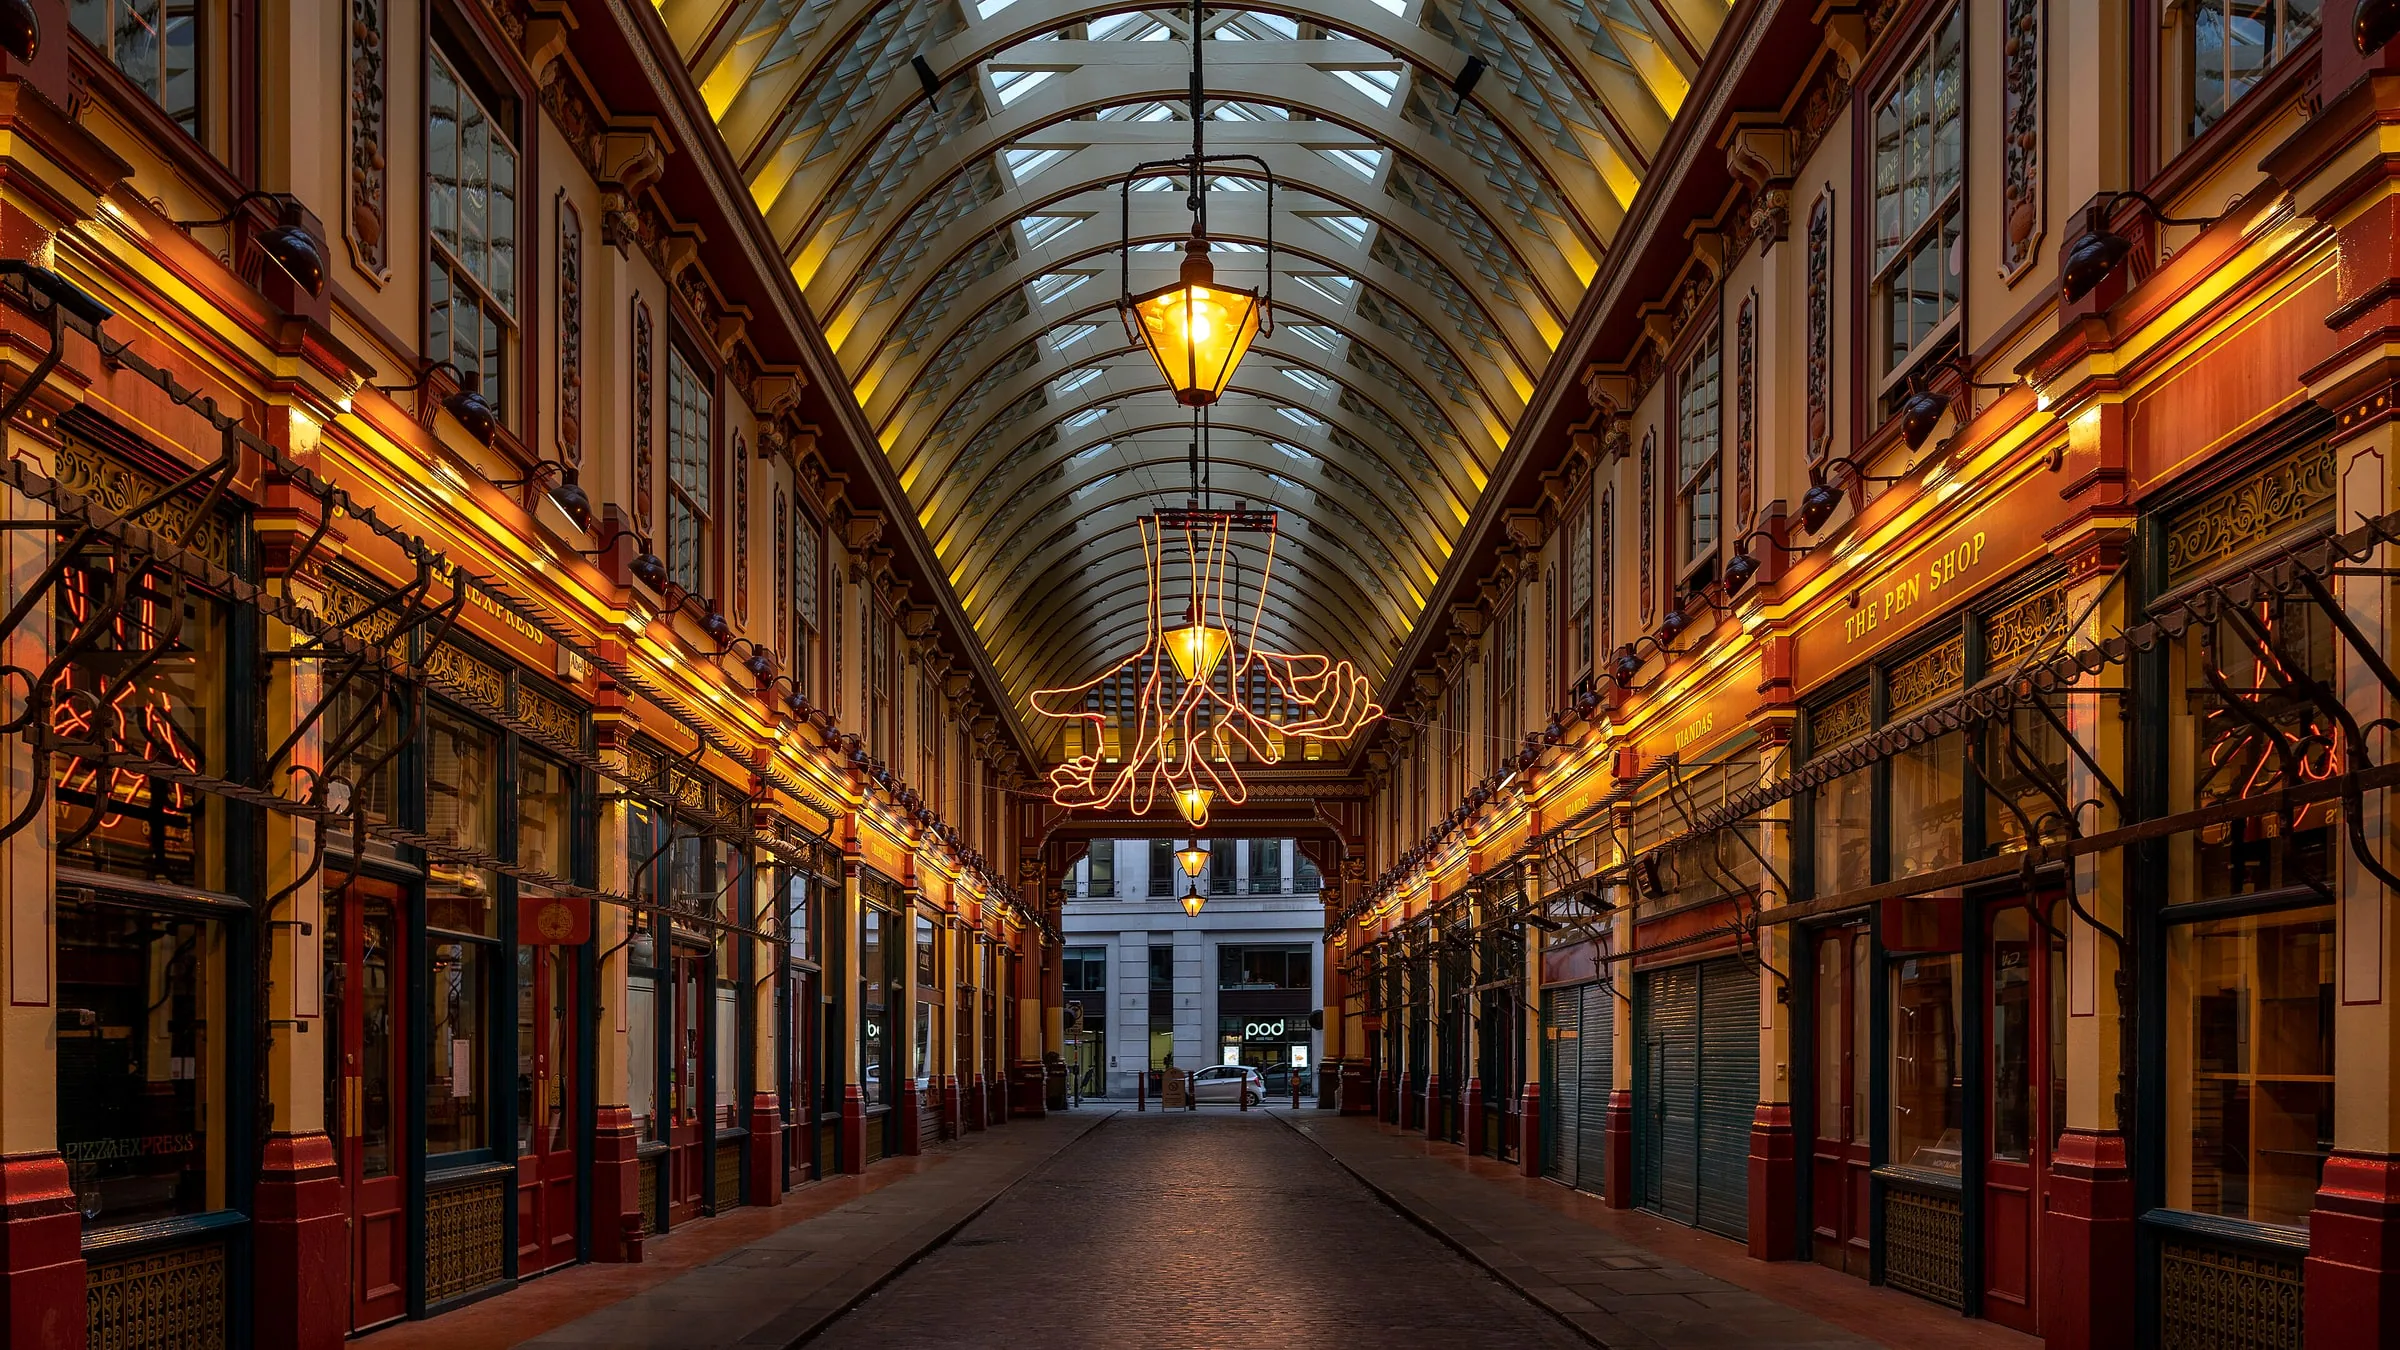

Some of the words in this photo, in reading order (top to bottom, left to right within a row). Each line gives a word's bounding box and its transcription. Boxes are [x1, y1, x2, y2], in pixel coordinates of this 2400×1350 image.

[1845, 601, 1878, 644] THE
[1884, 573, 1920, 621] PEN
[1929, 531, 1986, 592] SHOP
[1674, 712, 1713, 750] VIANDAS
[1245, 1018, 1285, 1040] pod
